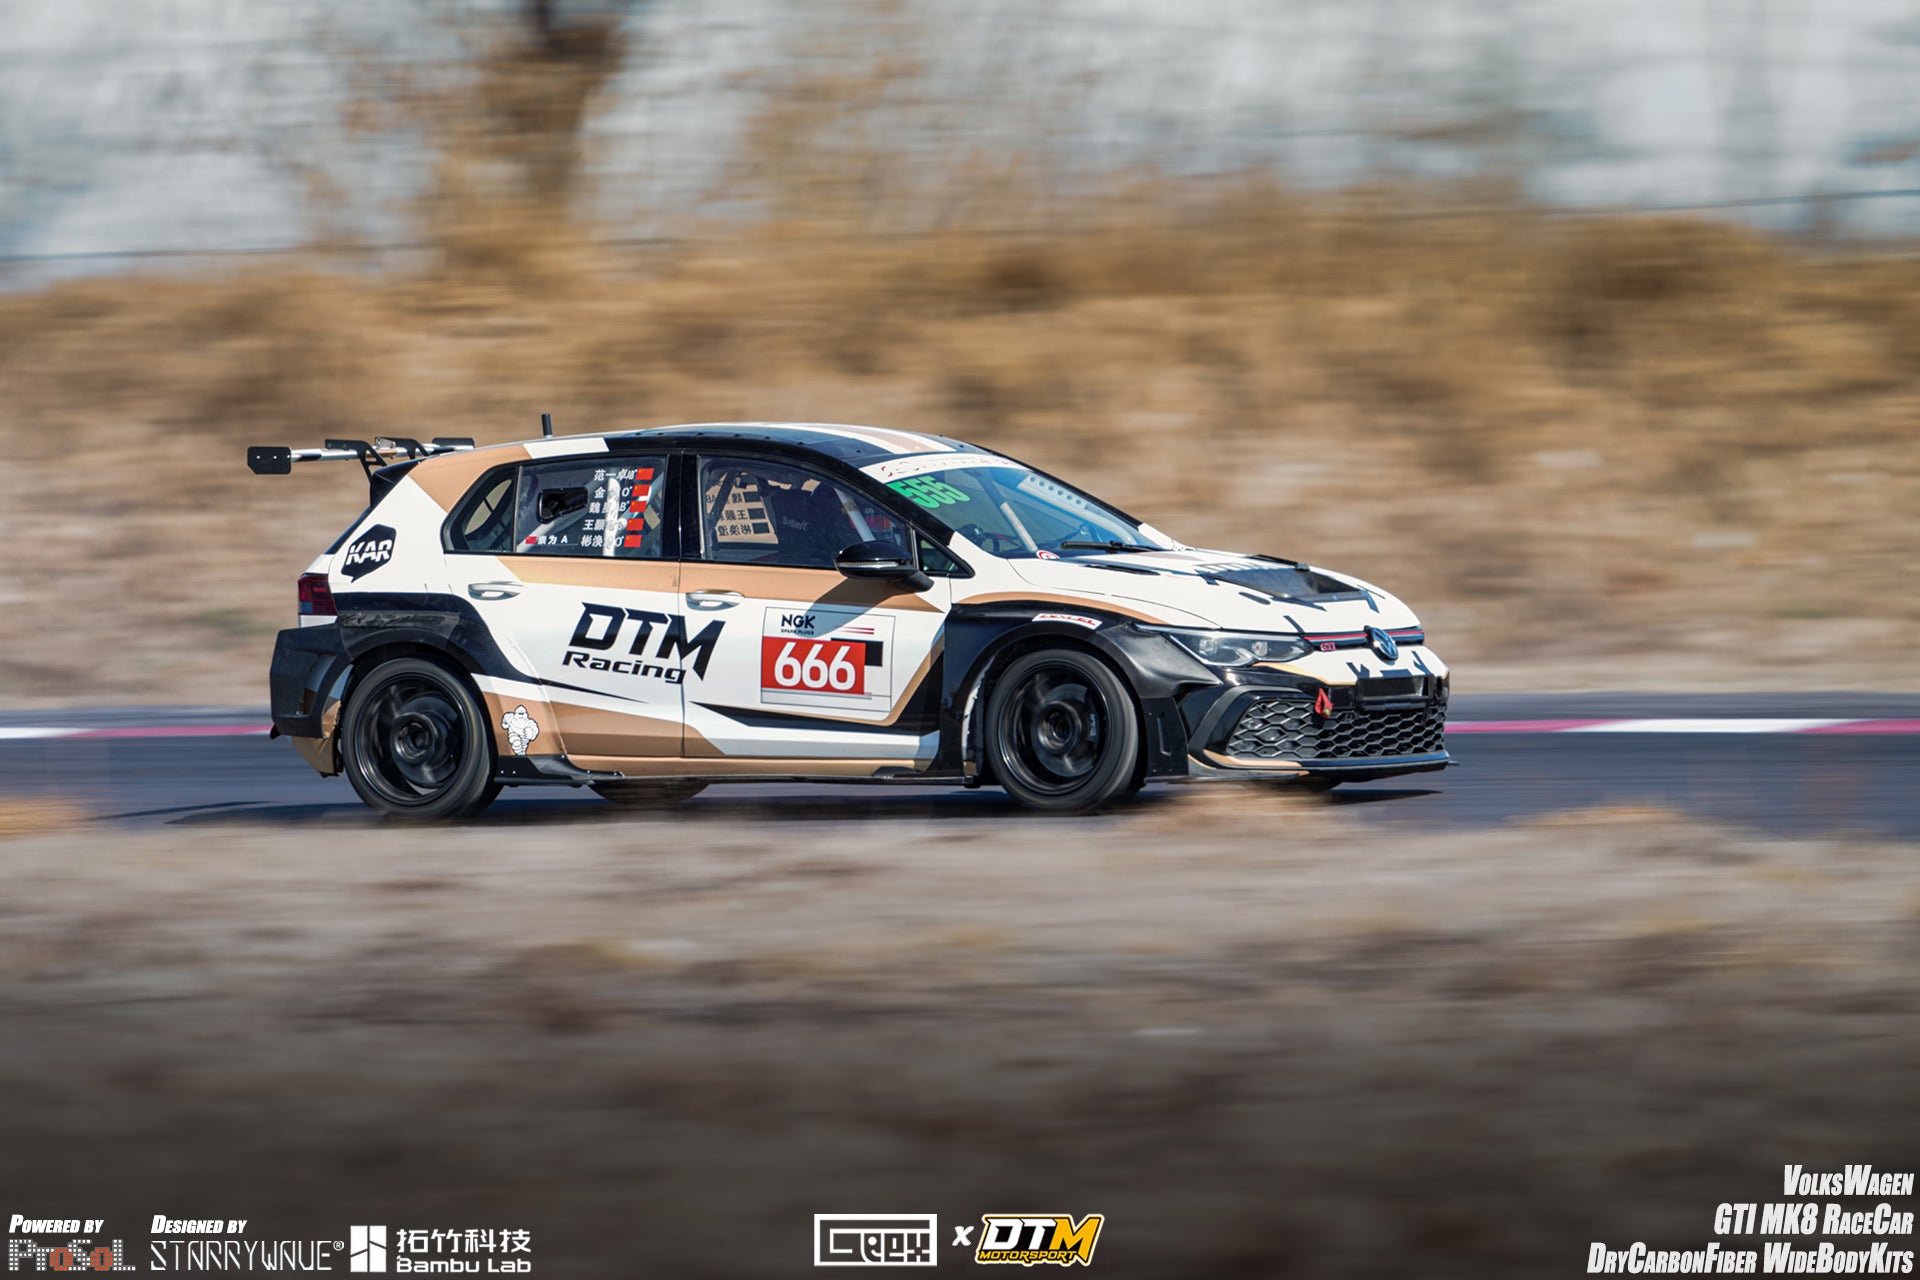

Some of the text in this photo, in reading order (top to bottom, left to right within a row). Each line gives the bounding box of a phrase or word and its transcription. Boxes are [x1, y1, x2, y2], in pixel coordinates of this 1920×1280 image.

[887, 475, 970, 508] 555
[345, 539, 393, 566] KAR
[781, 613, 816, 629] NGK
[569, 602, 726, 681] DTM
[1320, 642, 1337, 652] GTI
[562, 651, 688, 685] Racing
[774, 642, 857, 692] 666
